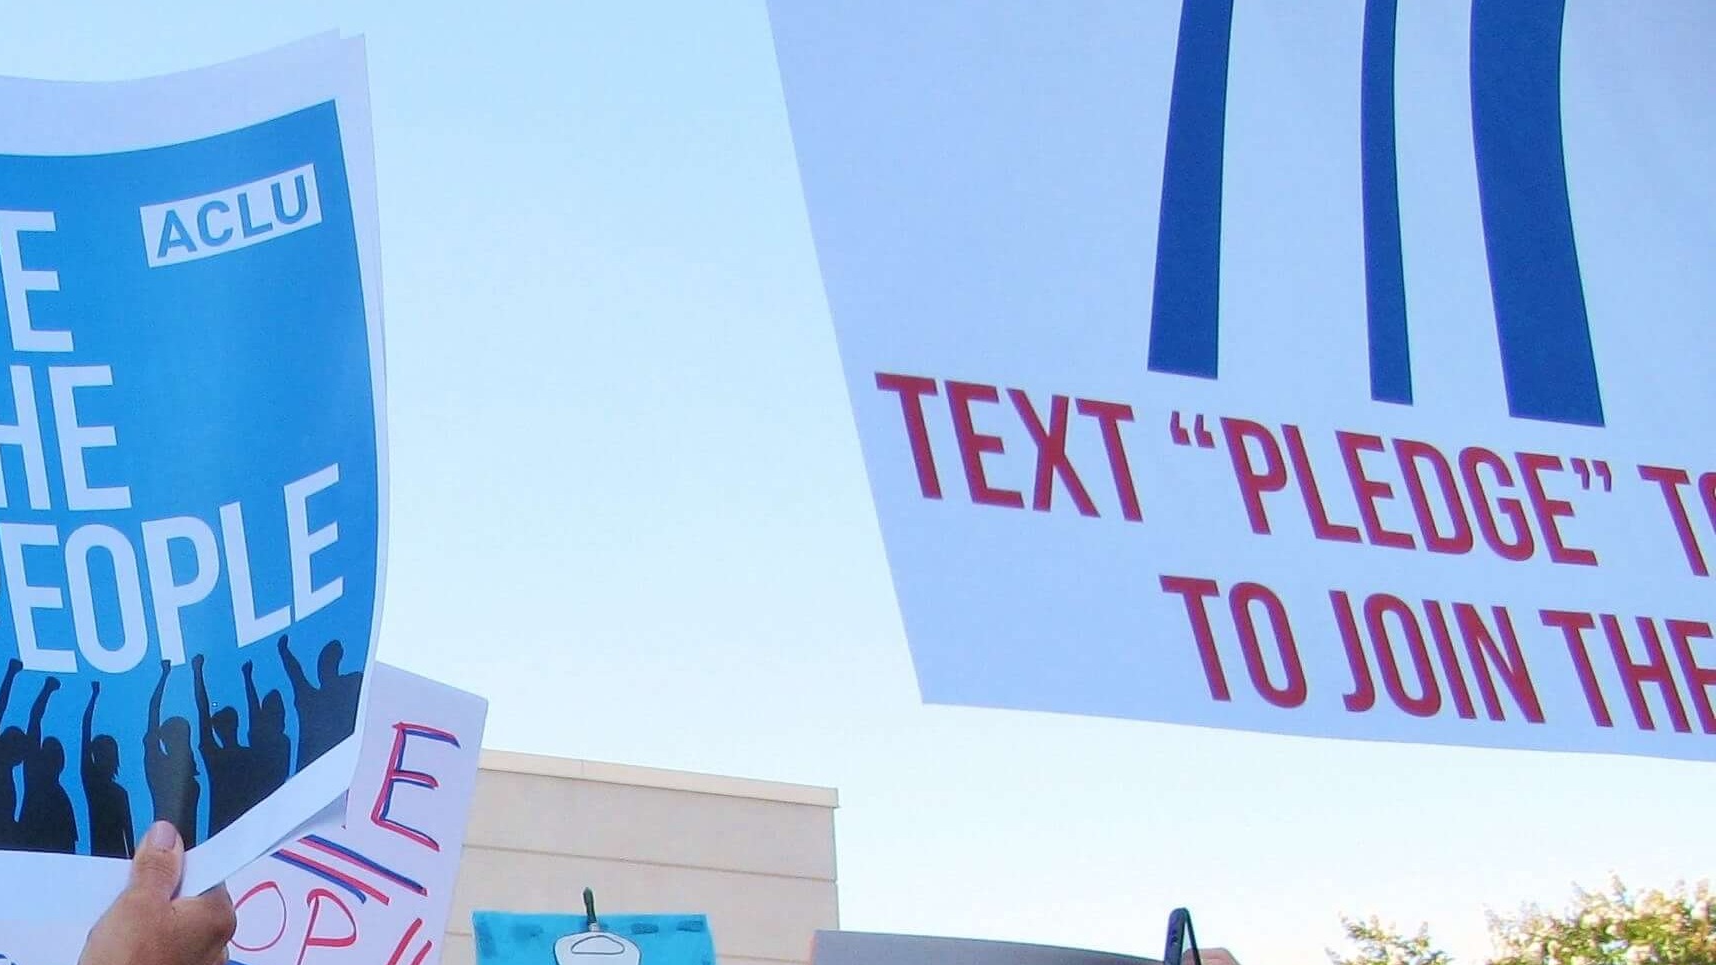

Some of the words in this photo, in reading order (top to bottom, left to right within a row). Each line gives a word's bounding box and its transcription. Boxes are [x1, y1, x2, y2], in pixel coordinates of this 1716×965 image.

[155, 174, 311, 259] ACLU
[874, 371, 1144, 524] TEXT
[1636, 464, 1716, 577] T
[1158, 573, 1308, 710] TO
[1329, 588, 1546, 725] JOIN
[1537, 608, 1716, 735] THE
